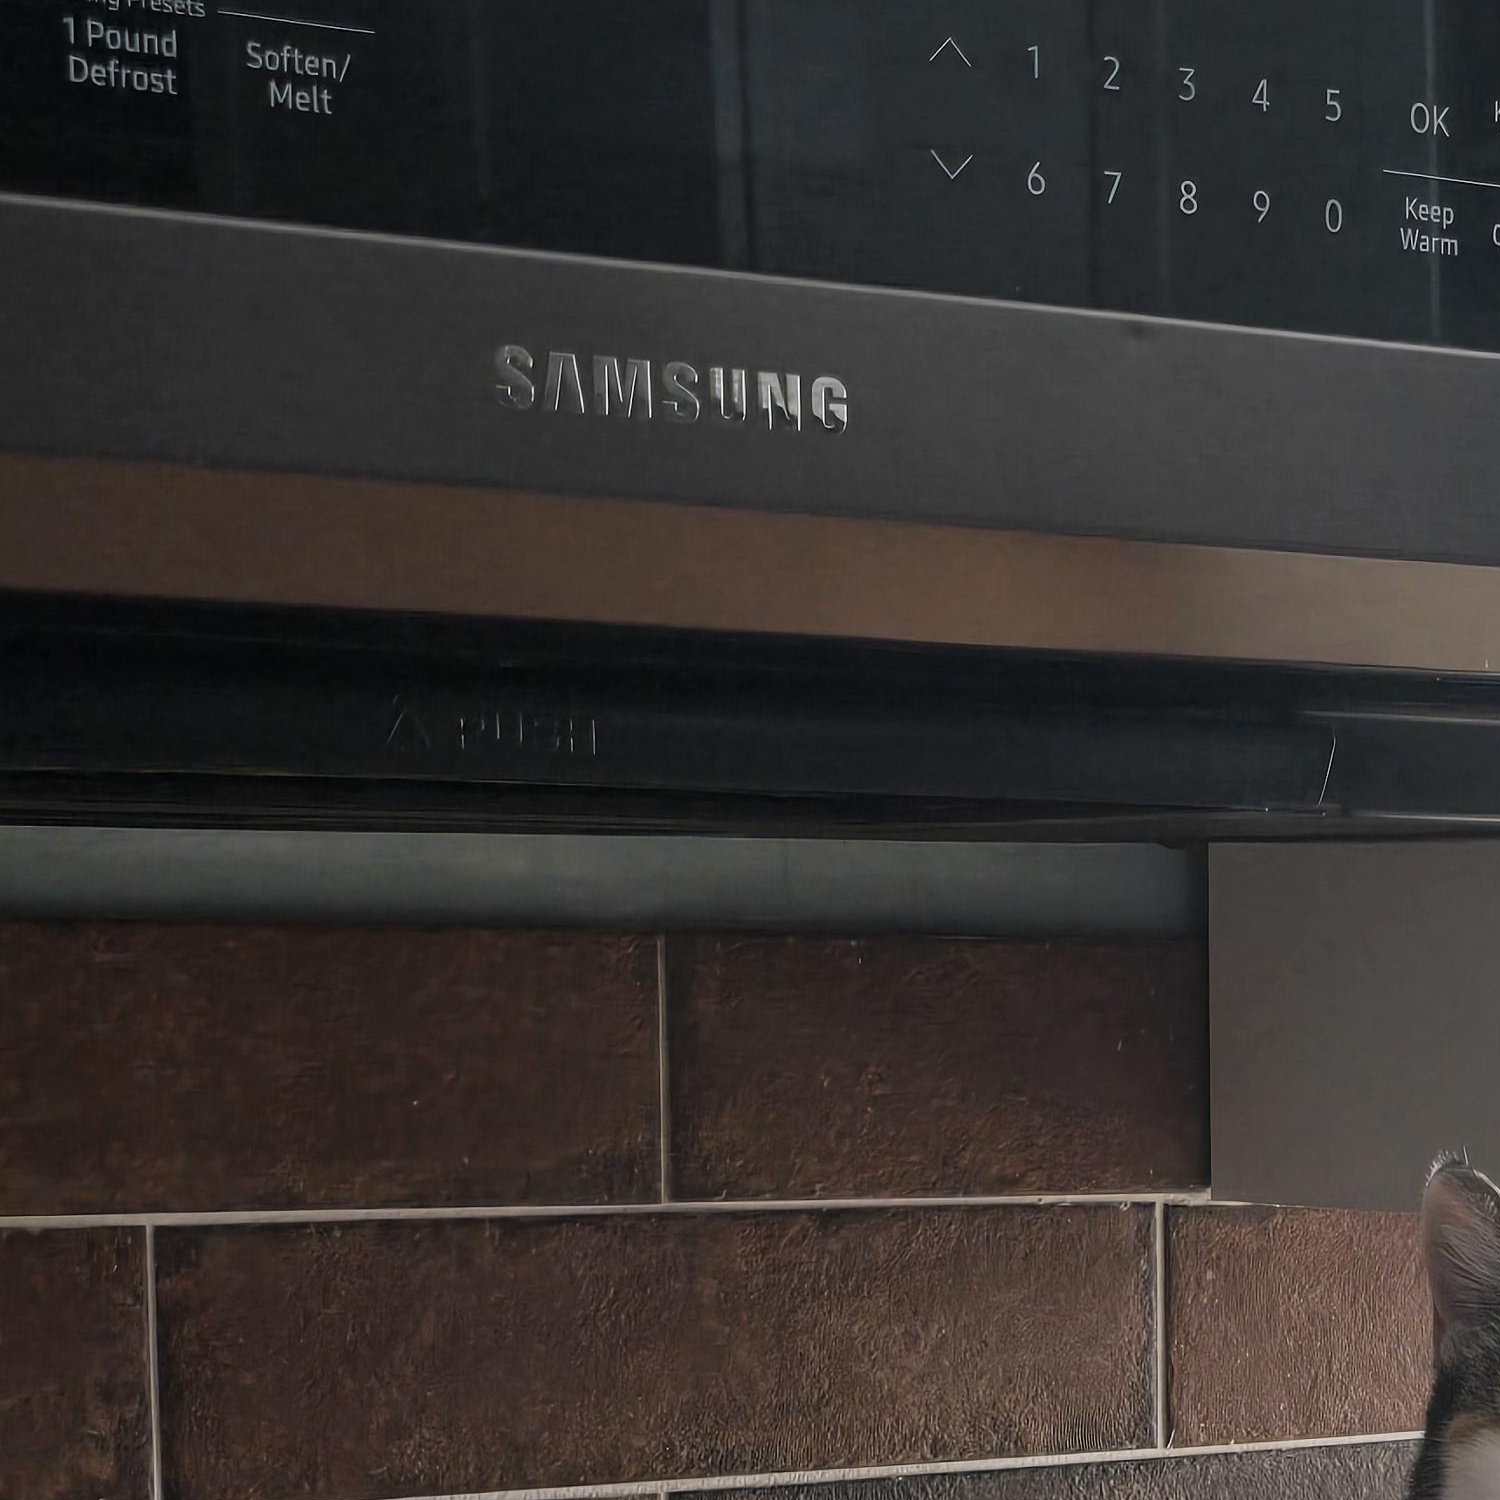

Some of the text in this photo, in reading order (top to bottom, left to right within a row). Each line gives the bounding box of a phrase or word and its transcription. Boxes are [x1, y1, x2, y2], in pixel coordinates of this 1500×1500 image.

[62, 17, 178, 59] 1 Pound
[67, 54, 179, 96] Defrost
[245, 41, 351, 84] Soften/
[1026, 44, 1343, 123] 1 2 3 4 5
[267, 78, 333, 116] Melt
[1409, 102, 1451, 138] OK
[1026, 160, 1344, 234] 6 7 8 9 0
[1404, 196, 1456, 227] Keep
[1399, 227, 1459, 257] Warm
[494, 344, 850, 434] SAMSUNG
